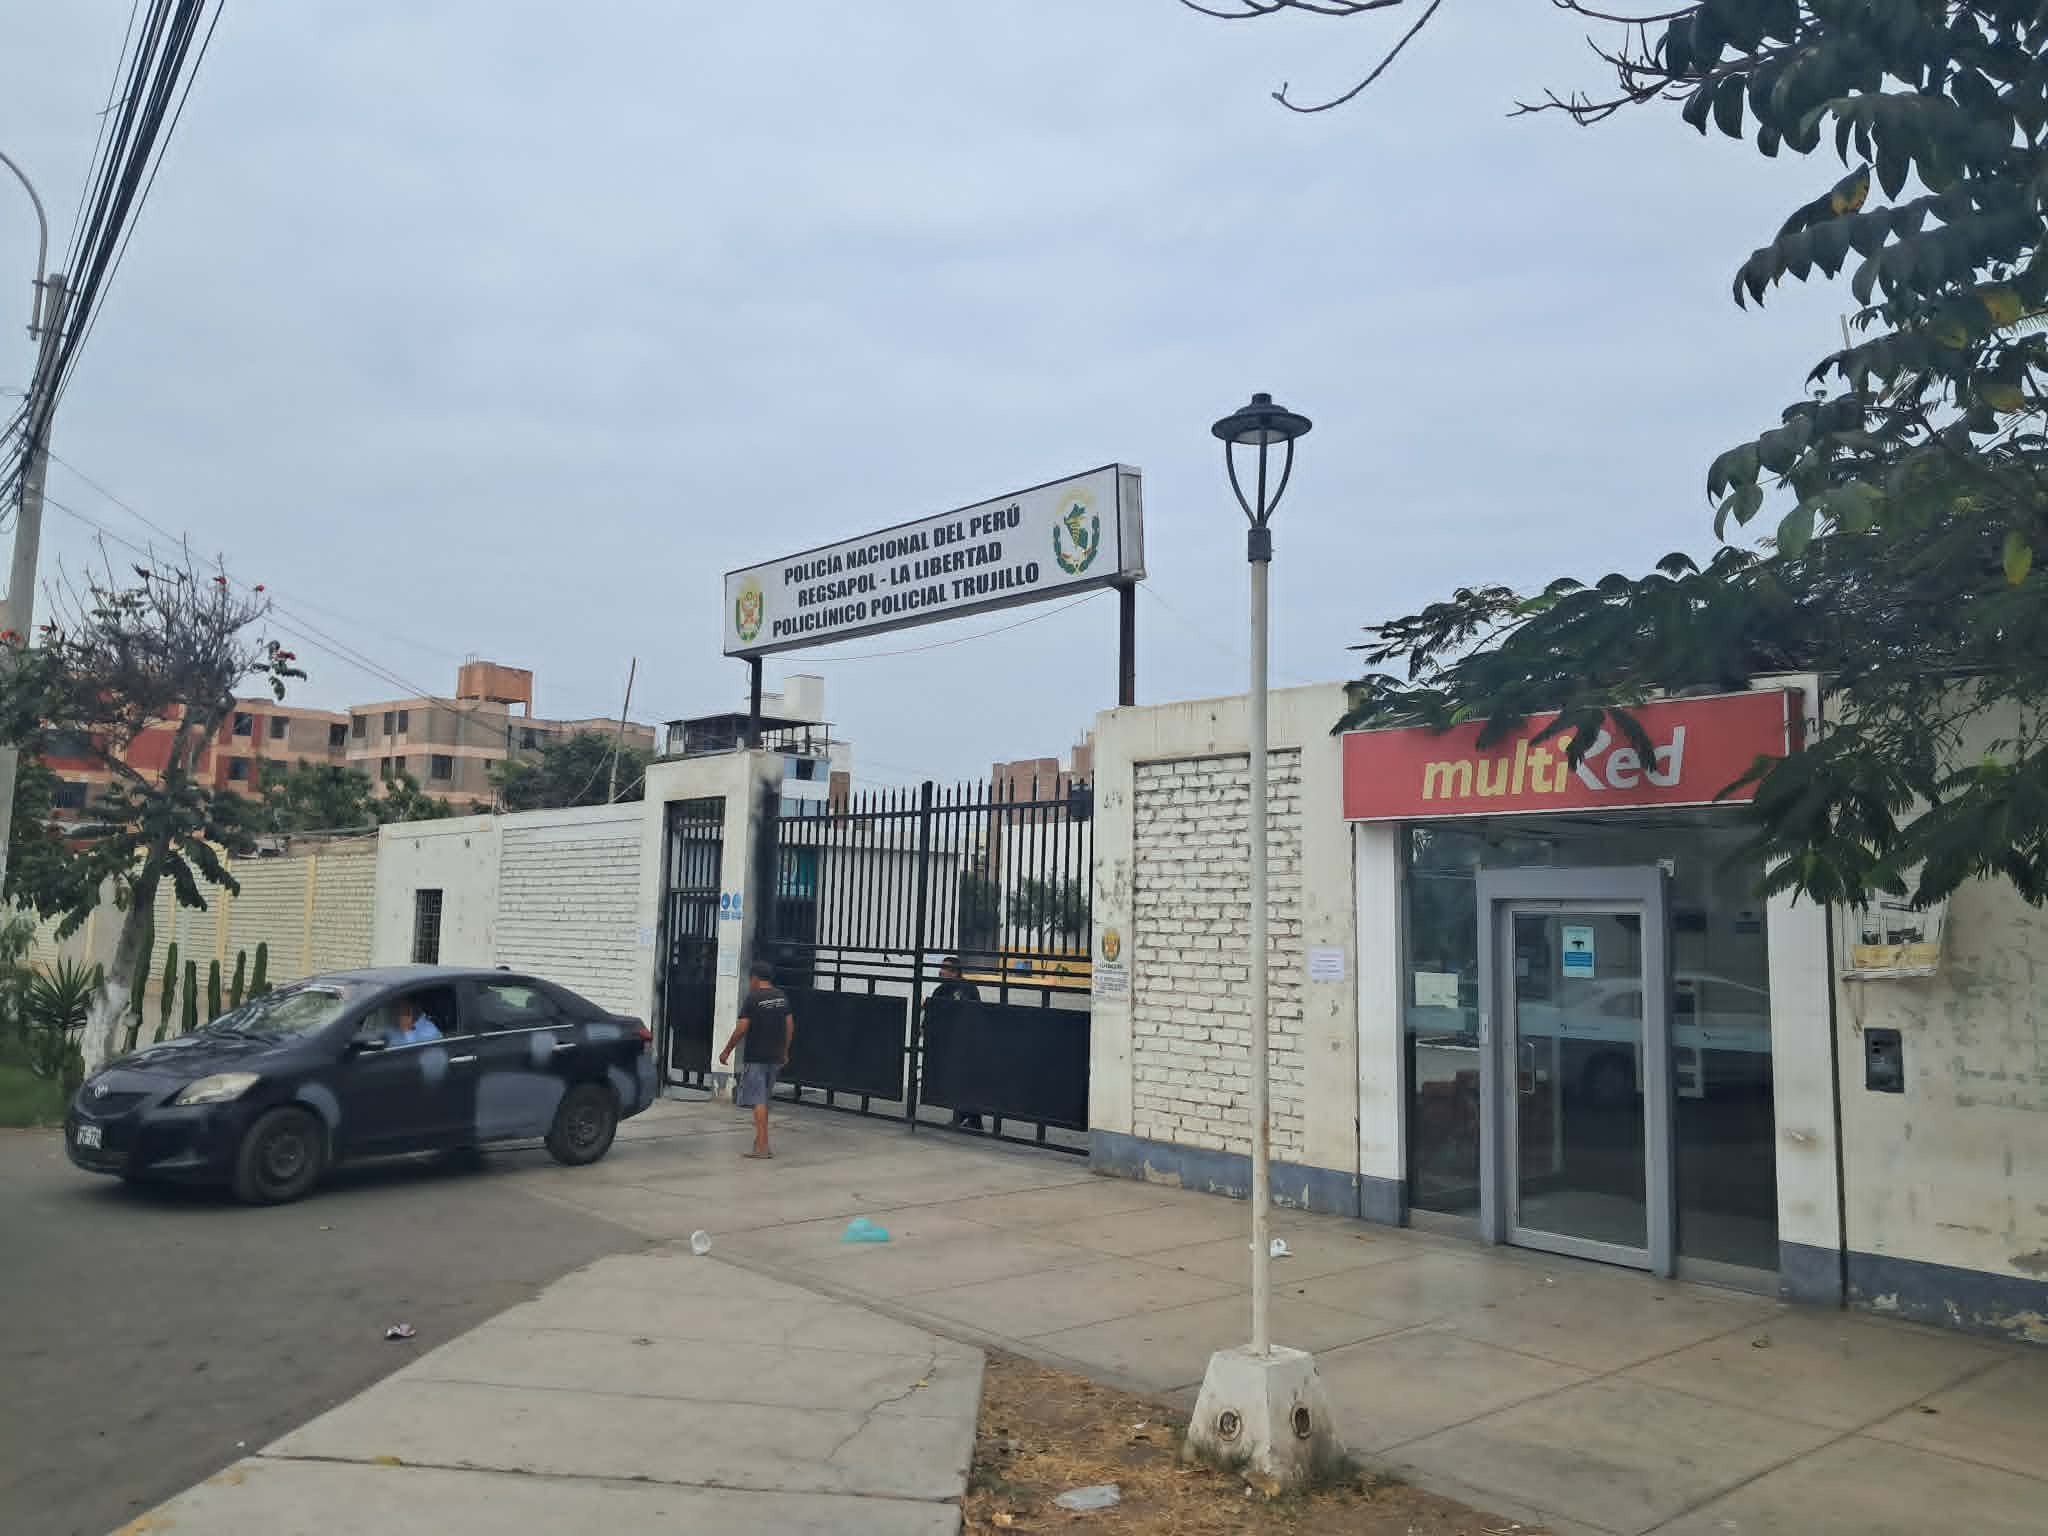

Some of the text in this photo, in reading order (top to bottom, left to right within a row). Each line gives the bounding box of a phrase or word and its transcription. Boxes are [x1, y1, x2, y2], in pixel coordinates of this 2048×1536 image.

[784, 503, 1020, 586] POLICÍA NACIONAL DEL PERÚ
[798, 573, 877, 608] REGSAPOL
[890, 564, 911, 586] LA
[914, 541, 1002, 580] LIBERTAD
[773, 561, 1039, 637] POLICLÍNICO POLICIAL TRUJILLO
